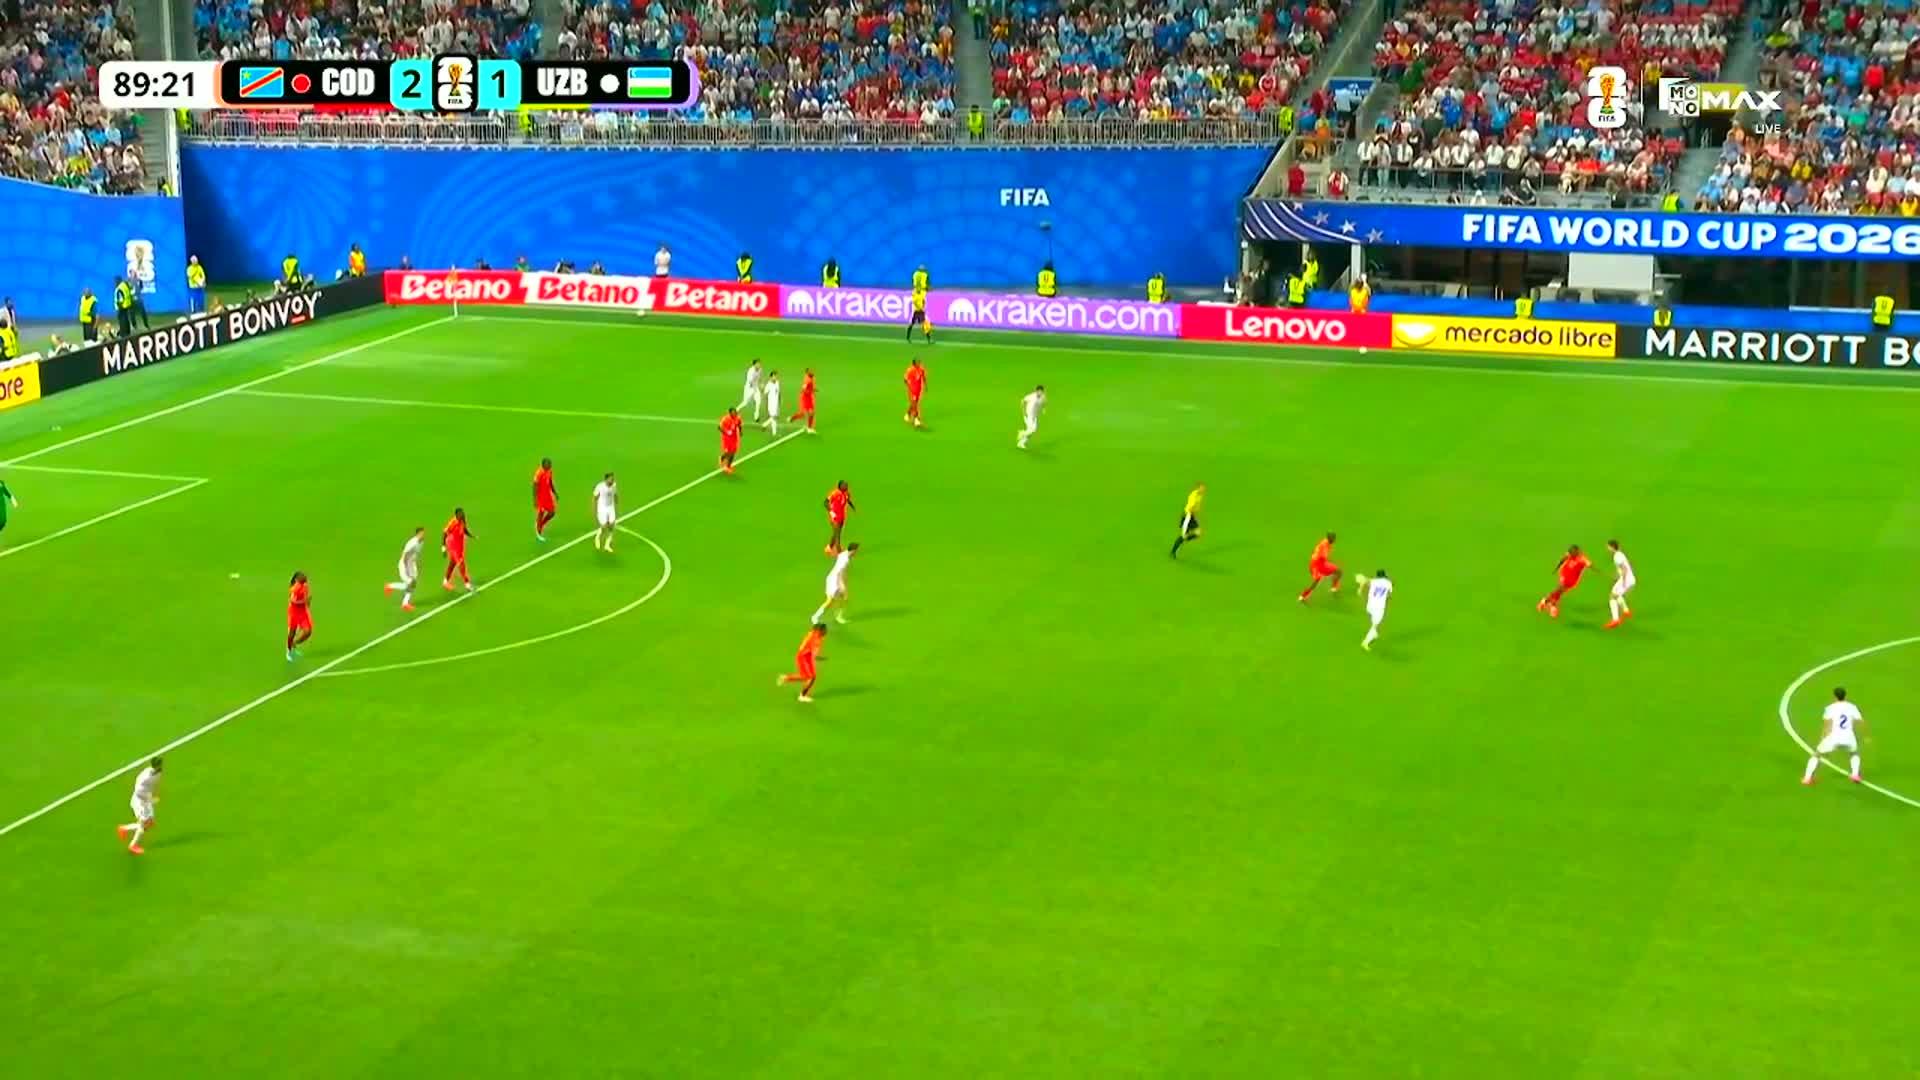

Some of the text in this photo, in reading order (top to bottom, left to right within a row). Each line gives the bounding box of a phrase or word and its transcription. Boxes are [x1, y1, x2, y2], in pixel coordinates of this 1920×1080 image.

[1000, 187, 1050, 207] FIFA
[1463, 213, 1920, 255] FIFA WORLD CUP 2026
[400, 273, 511, 301] Betano
[537, 276, 640, 305] Betano
[665, 281, 768, 312] Betano
[977, 296, 1175, 332] kraken.com
[1225, 310, 1347, 342] Lenovo
[103, 294, 317, 375] MARRIOTT BONVOY
[1445, 325, 1613, 348] mercado libre
[1645, 327, 1920, 367] MARRIOTT B
[1839, 714, 1848, 730] 2
